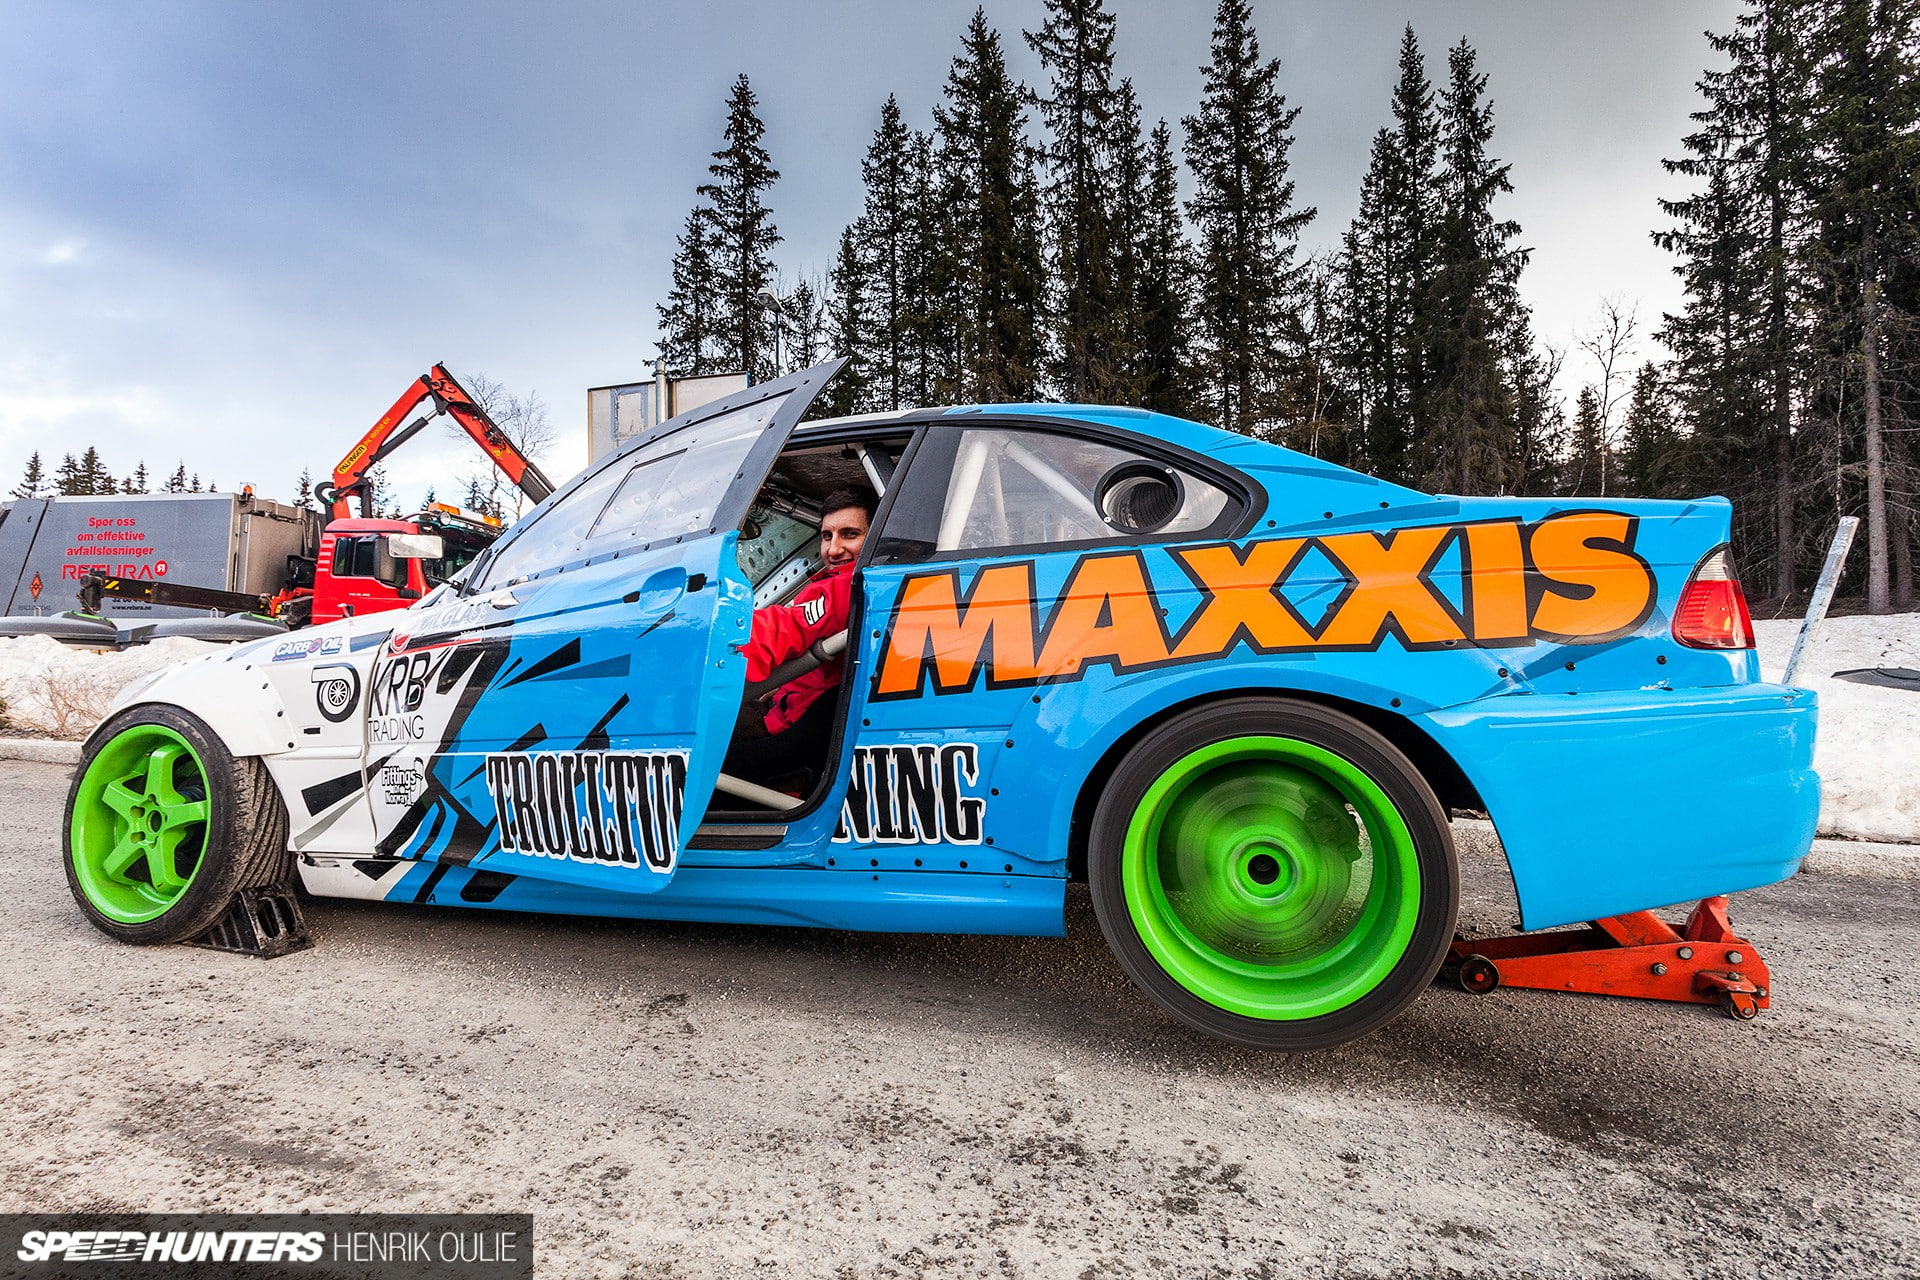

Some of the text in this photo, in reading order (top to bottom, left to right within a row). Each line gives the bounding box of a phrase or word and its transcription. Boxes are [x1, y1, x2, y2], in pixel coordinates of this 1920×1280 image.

[339, 447, 365, 472] PALFINGER
[88, 516, 136, 529] Spør oss
[76, 531, 145, 541] om effektive
[66, 546, 154, 557] avfallsløsninger
[869, 510, 1657, 702] MAXXIS
[368, 652, 425, 718] KRB
[368, 715, 424, 742] TRADING
[381, 766, 417, 791] Fittings
